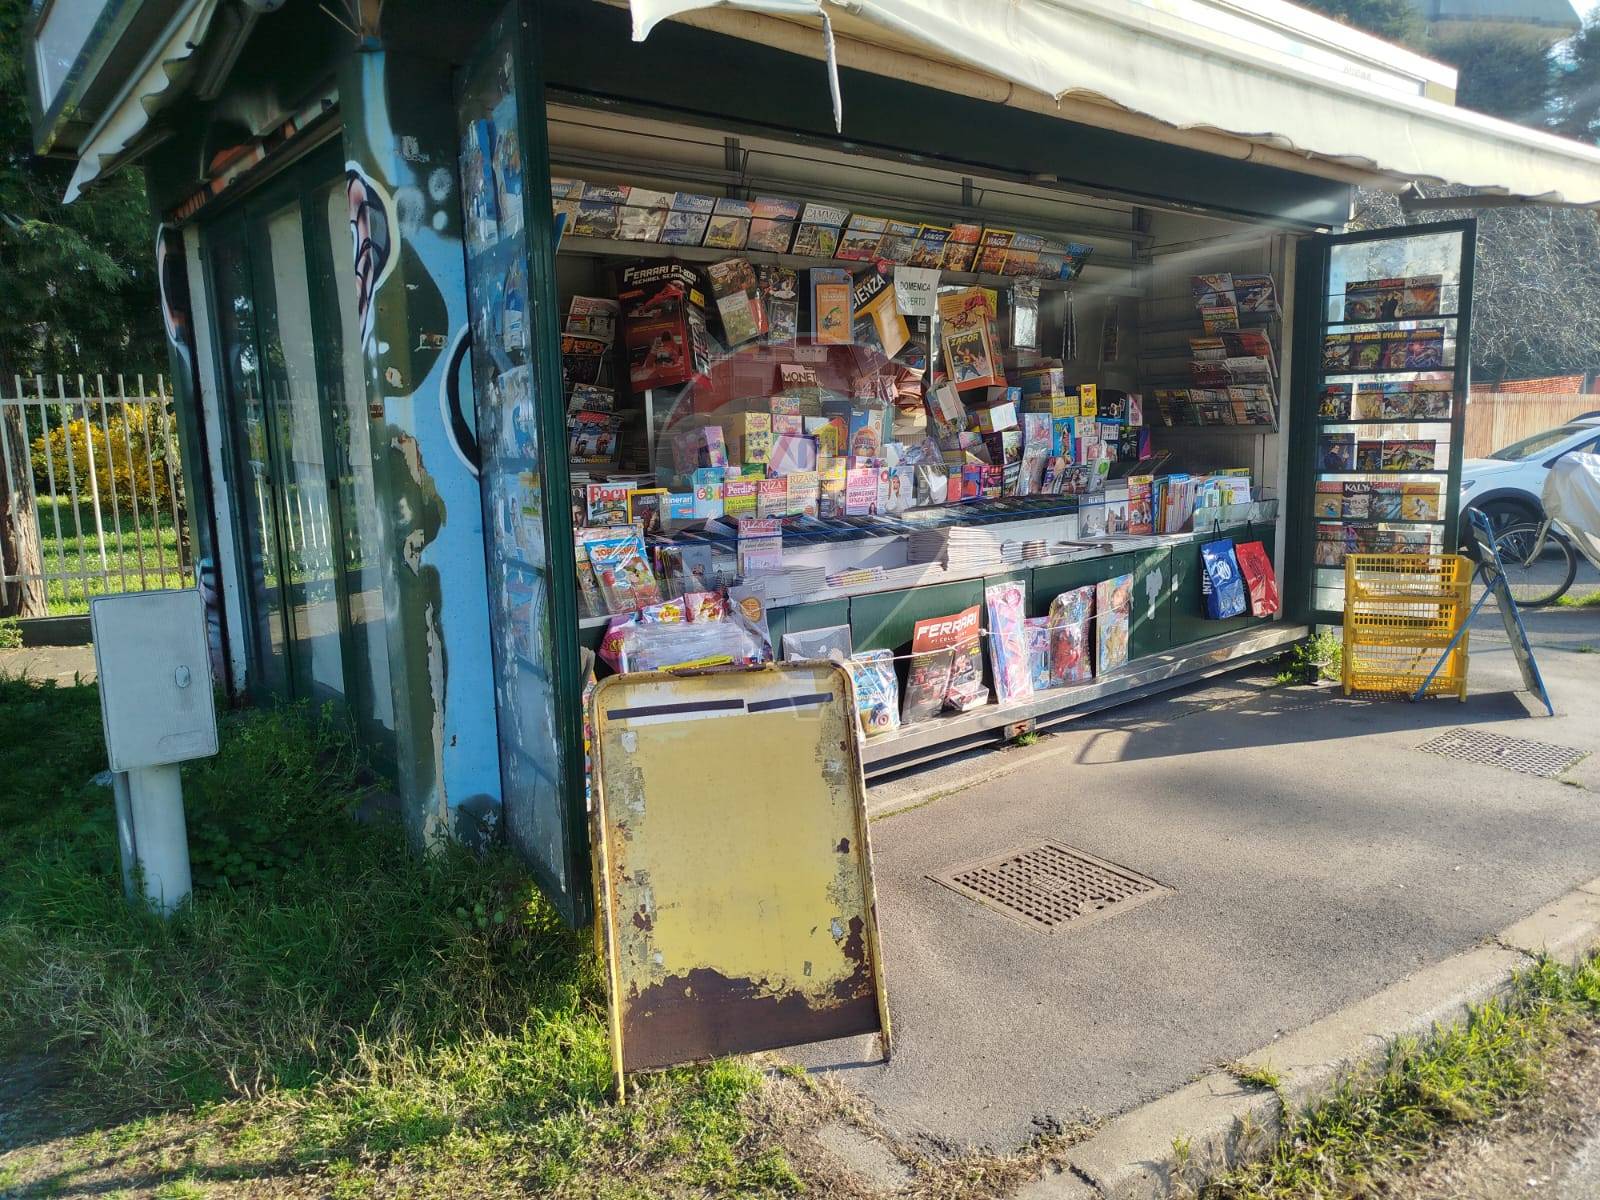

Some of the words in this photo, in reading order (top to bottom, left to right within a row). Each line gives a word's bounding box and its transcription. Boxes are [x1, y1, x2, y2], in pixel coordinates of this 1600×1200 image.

[924, 231, 945, 240] VIAGGI
[986, 237, 1008, 246] VIAGGI
[624, 265, 669, 282] FERRARI
[854, 274, 886, 309] IENZA
[899, 281, 931, 291] DOMENICA
[951, 333, 979, 345] ZAGOR
[783, 369, 816, 382] MONET
[591, 484, 627, 503] Focu
[728, 483, 758, 494] PerdiPe
[916, 611, 977, 641] FERRARI
